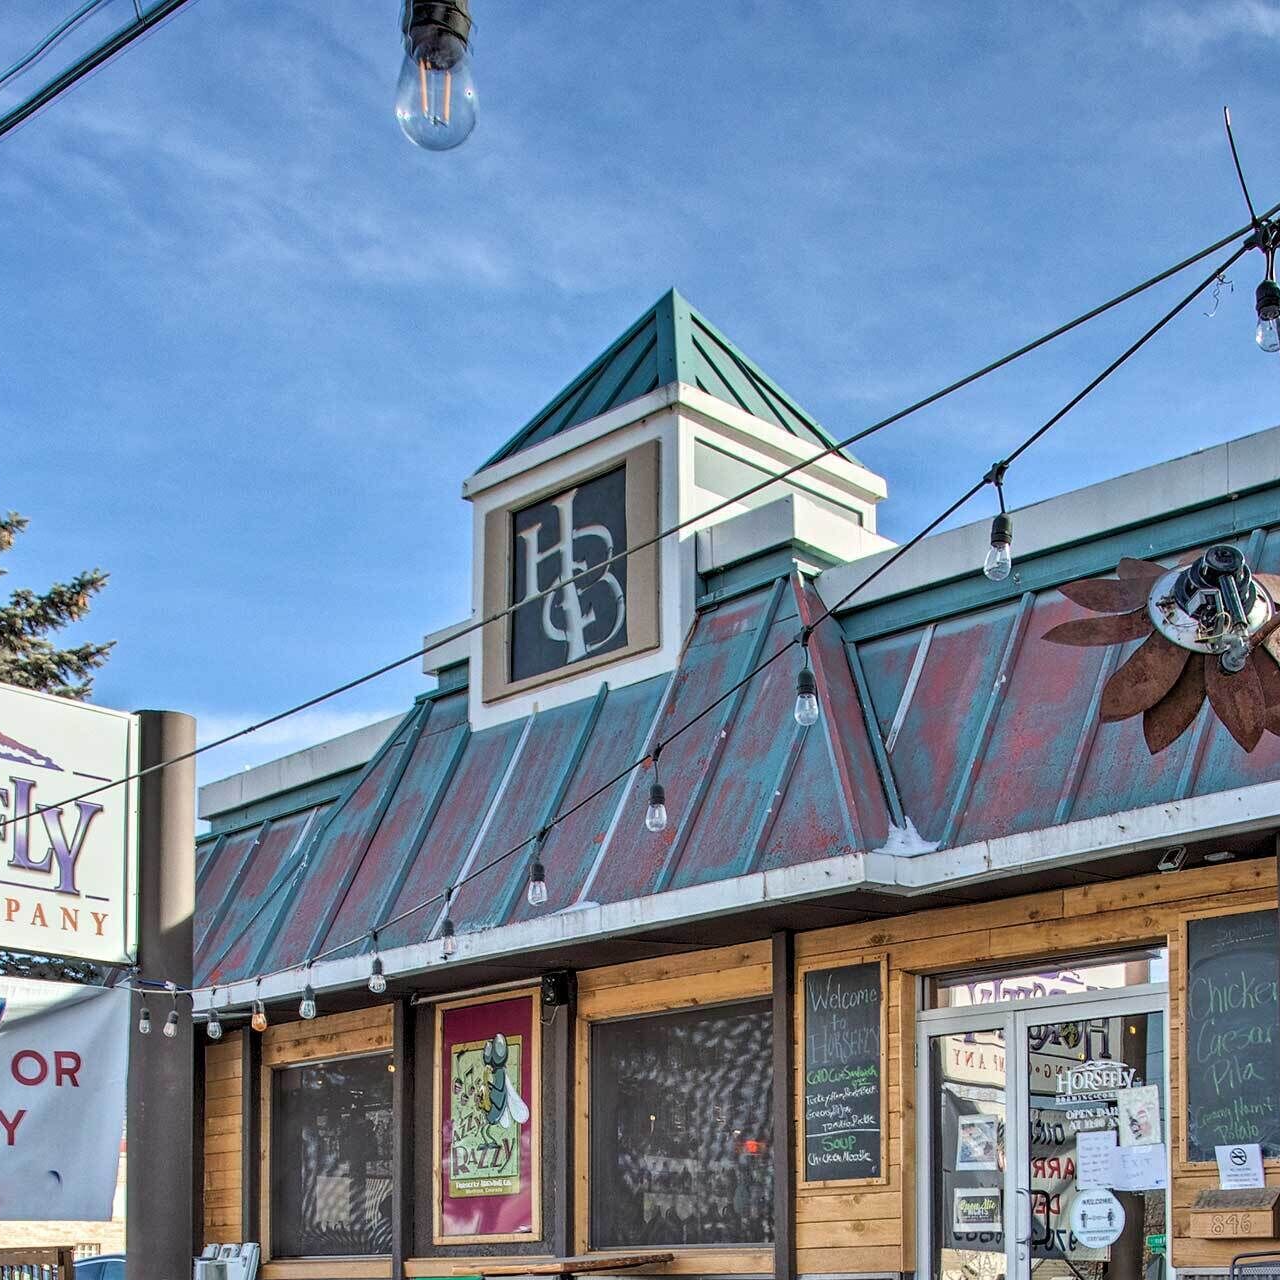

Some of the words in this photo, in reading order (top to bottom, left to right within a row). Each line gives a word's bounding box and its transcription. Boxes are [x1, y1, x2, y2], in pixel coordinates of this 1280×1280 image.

[809, 974, 878, 1013] Welcome
[832, 1014, 847, 1031] to
[10, 1048, 83, 1088] OR
[1056, 1068, 1137, 1095] HORSEFLY
[1210, 1213, 1253, 1236] 846
